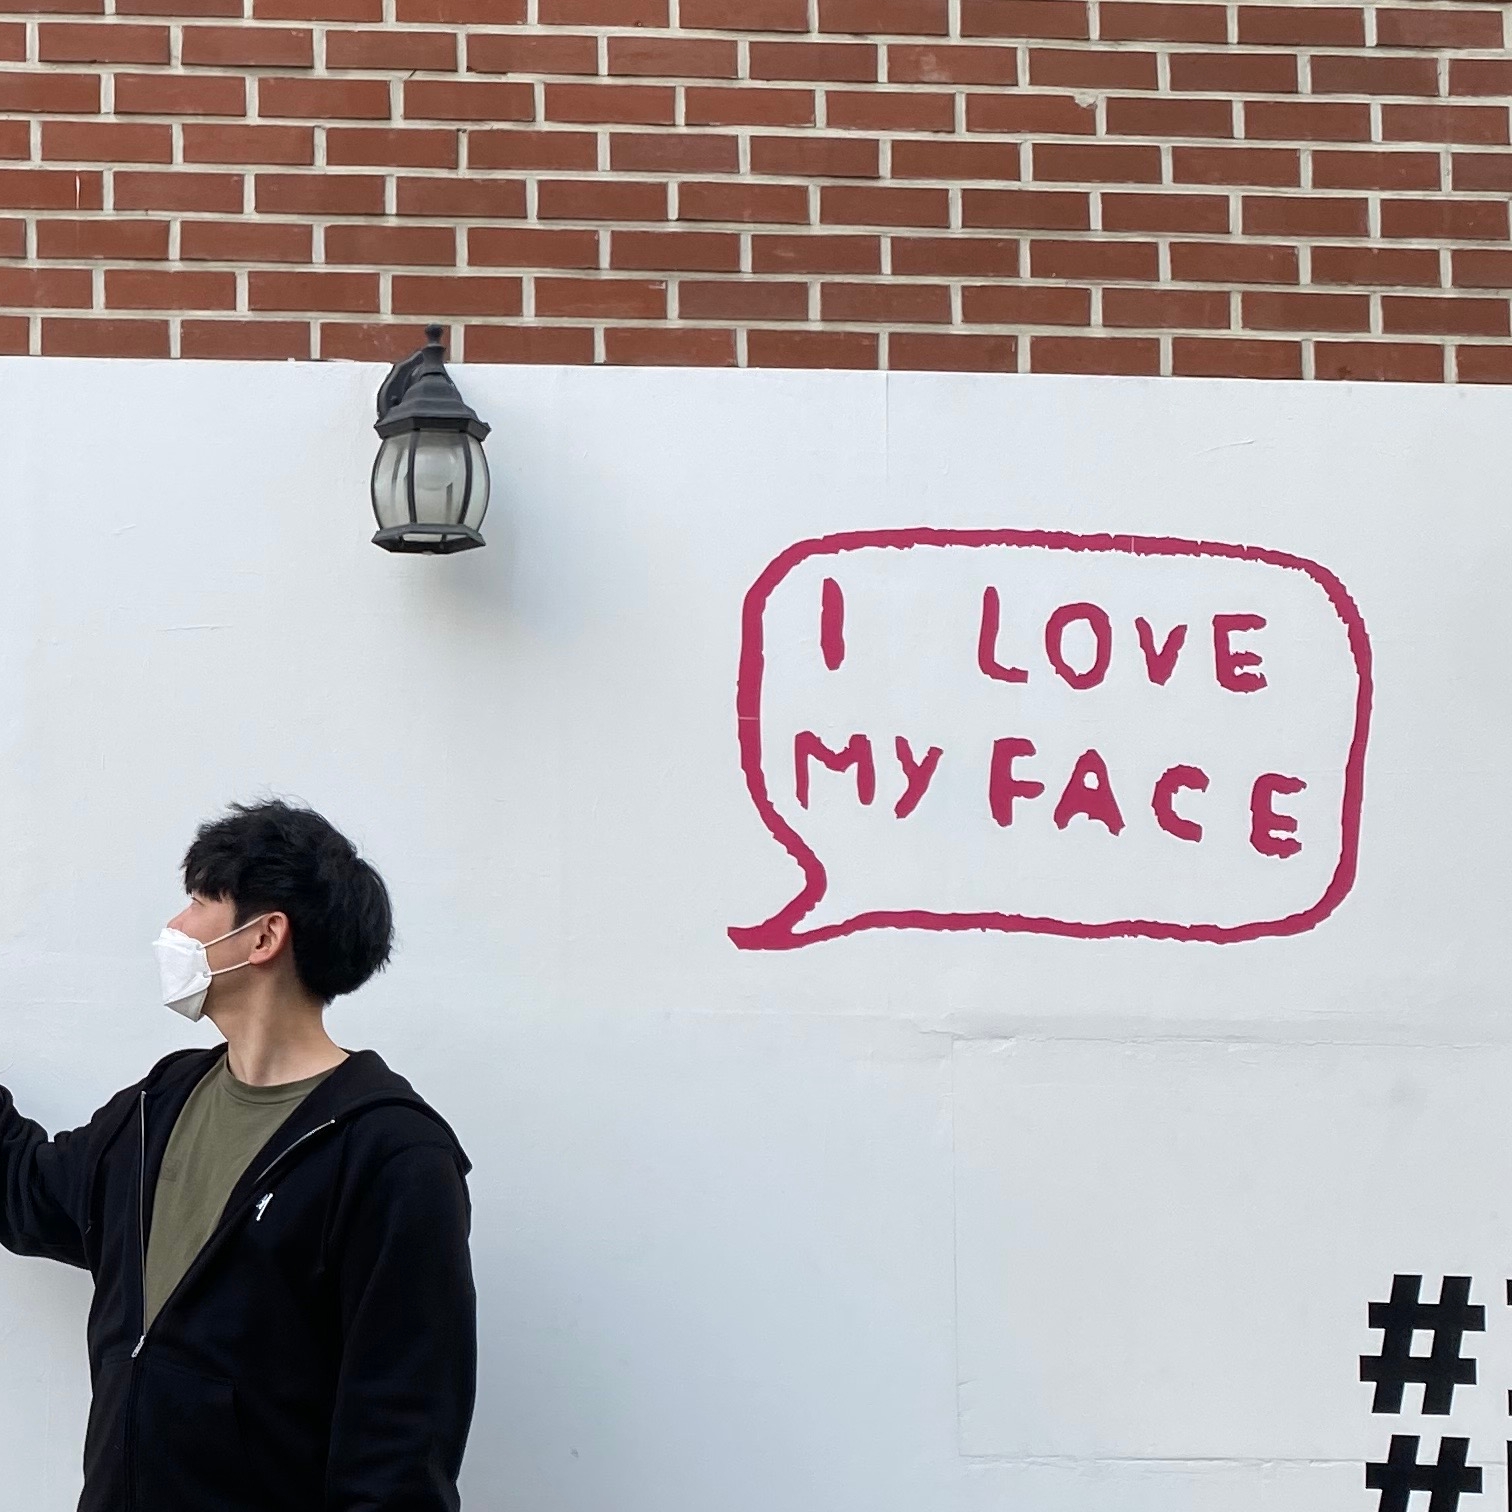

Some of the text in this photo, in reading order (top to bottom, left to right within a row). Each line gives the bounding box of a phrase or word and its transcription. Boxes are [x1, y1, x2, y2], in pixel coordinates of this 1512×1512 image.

[820, 577, 1267, 693] I LOVE
[989, 737, 1308, 859] FACE
